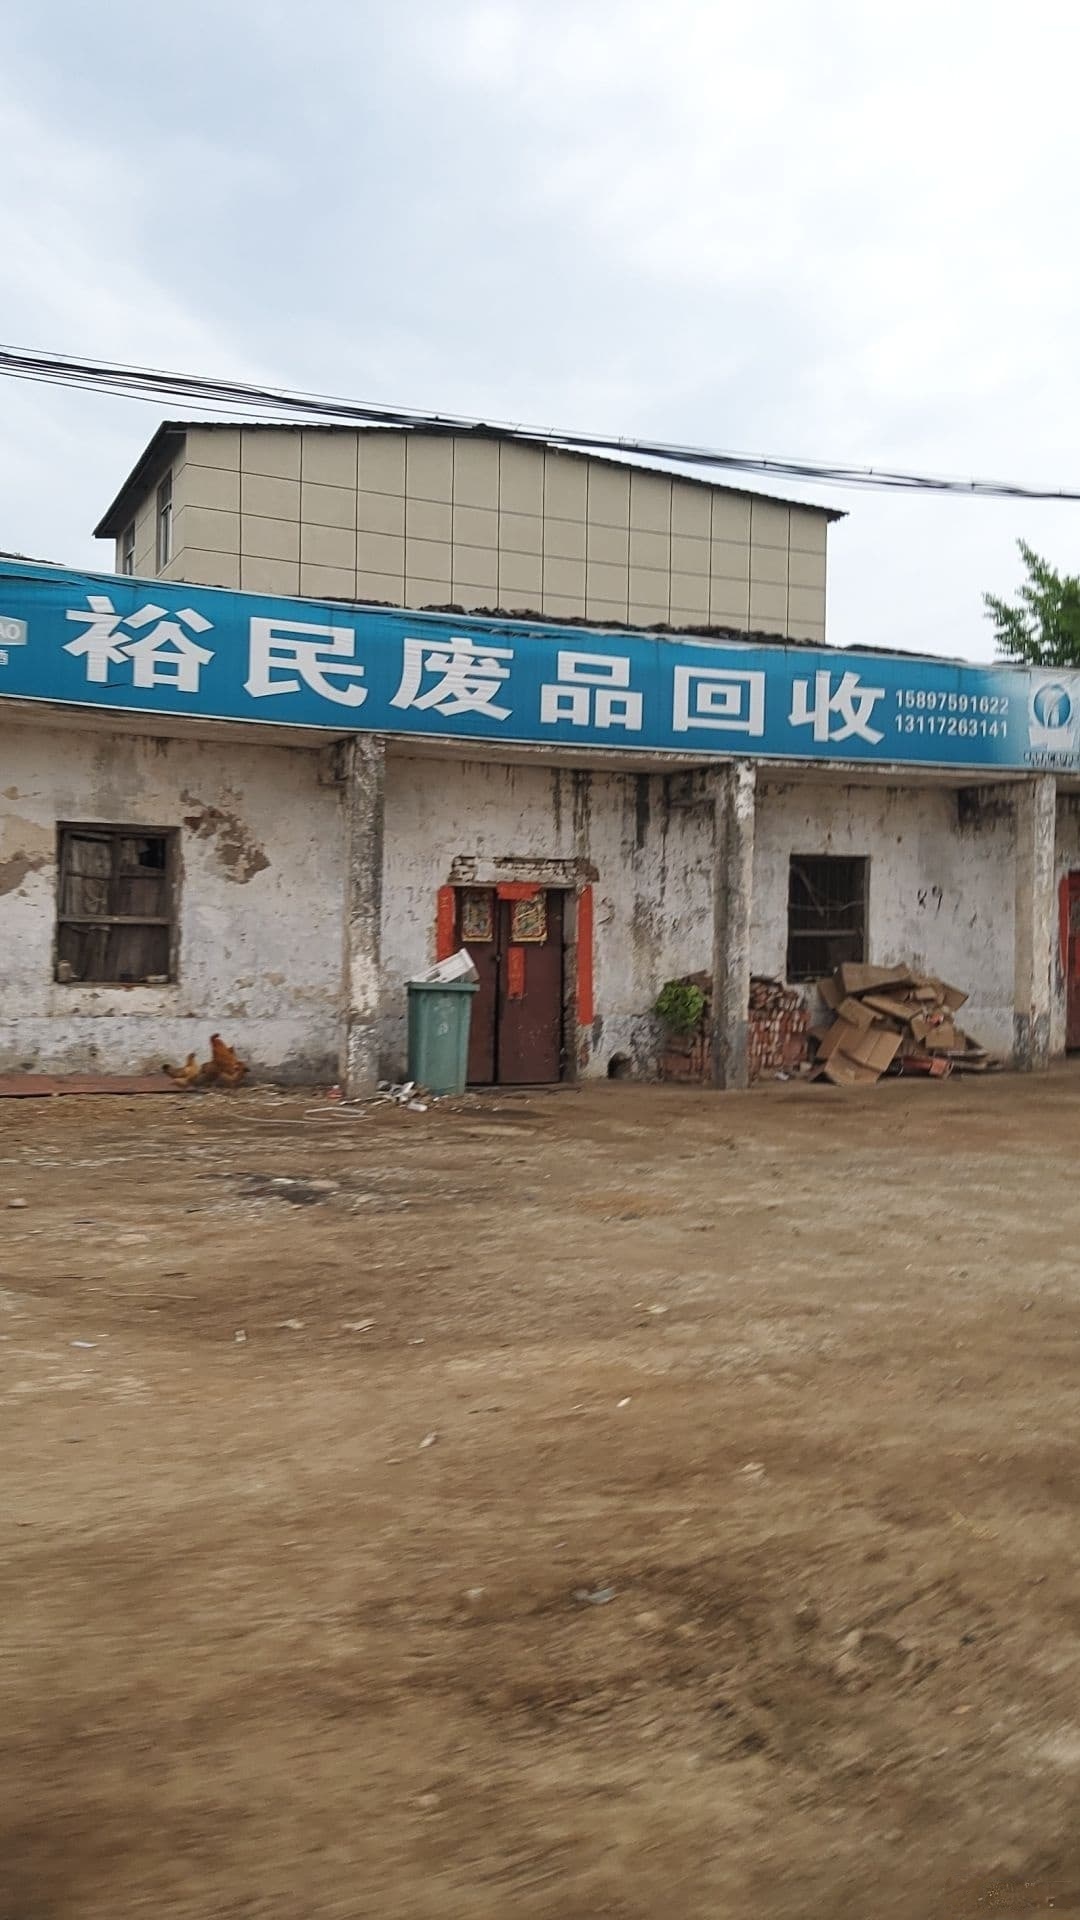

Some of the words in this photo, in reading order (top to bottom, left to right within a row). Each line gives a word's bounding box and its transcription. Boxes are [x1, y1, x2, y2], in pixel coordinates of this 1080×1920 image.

[63, 596, 885, 744] 裕民废品回收
